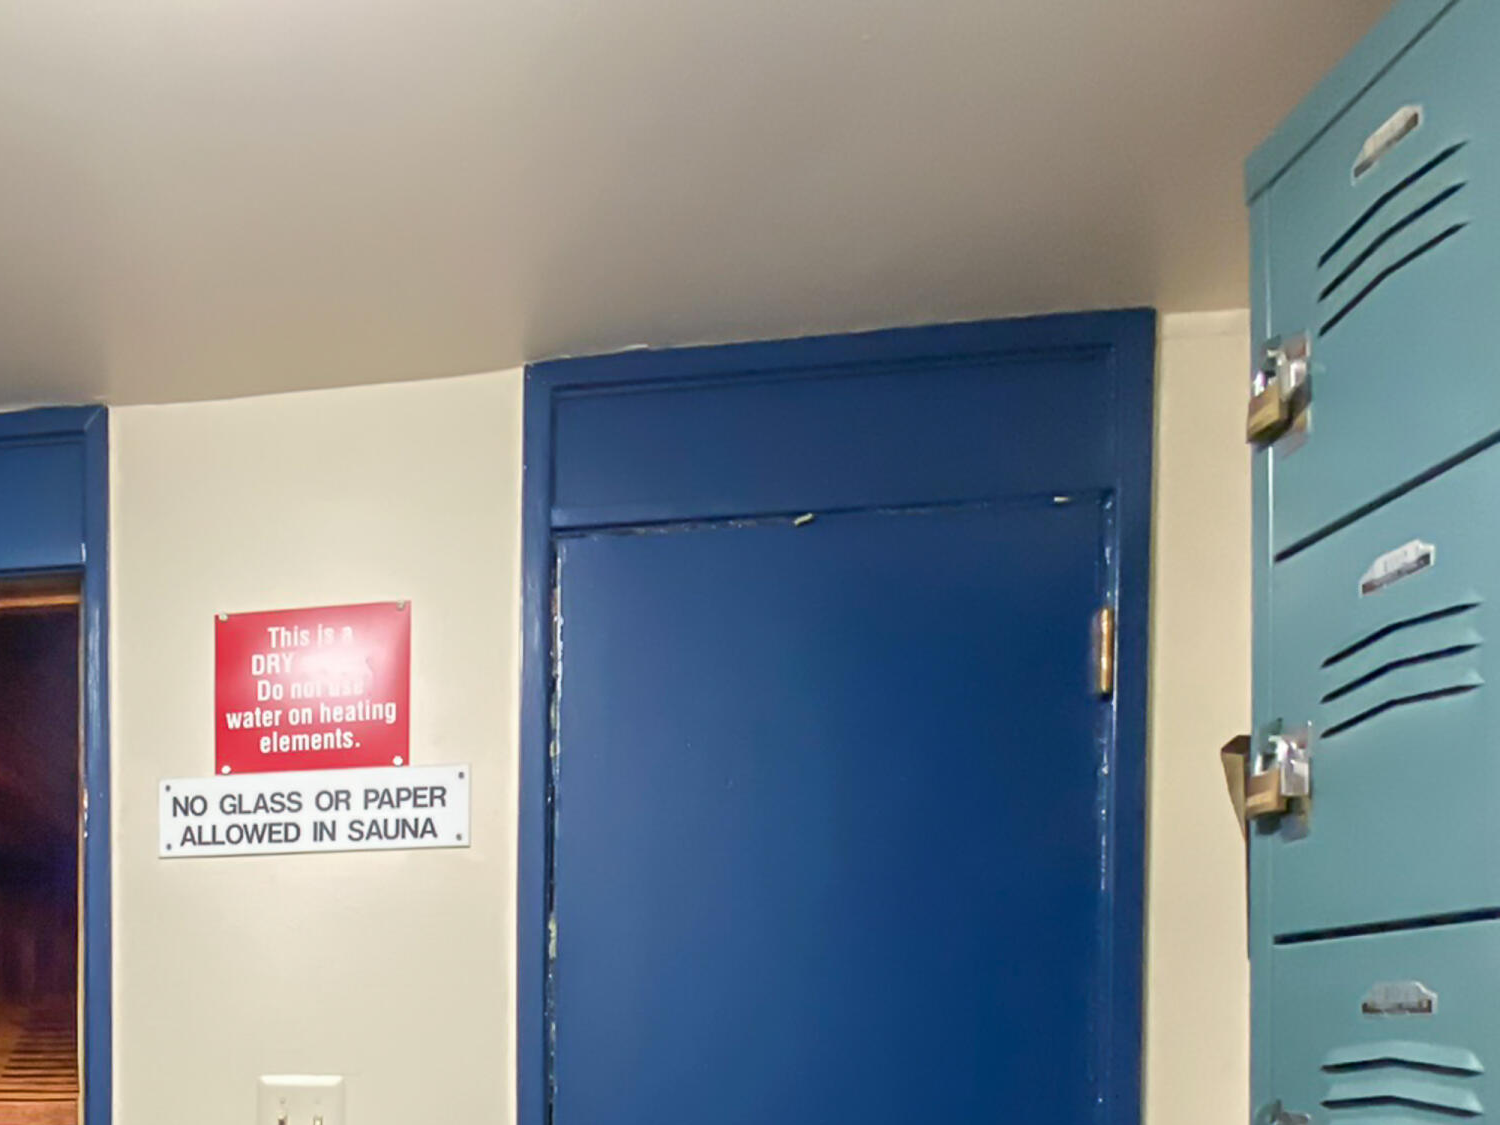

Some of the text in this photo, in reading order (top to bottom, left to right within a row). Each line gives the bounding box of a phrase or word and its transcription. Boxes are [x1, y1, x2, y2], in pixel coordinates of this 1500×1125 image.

[267, 623, 353, 648] This is a
[251, 653, 294, 676] DRY
[257, 679, 283, 701] Do
[225, 699, 397, 730] water on heating
[259, 728, 361, 754] elements.
[172, 786, 447, 817] NO GLASS OR PAPER
[180, 817, 438, 847] ALLOWED IN SAUNA
